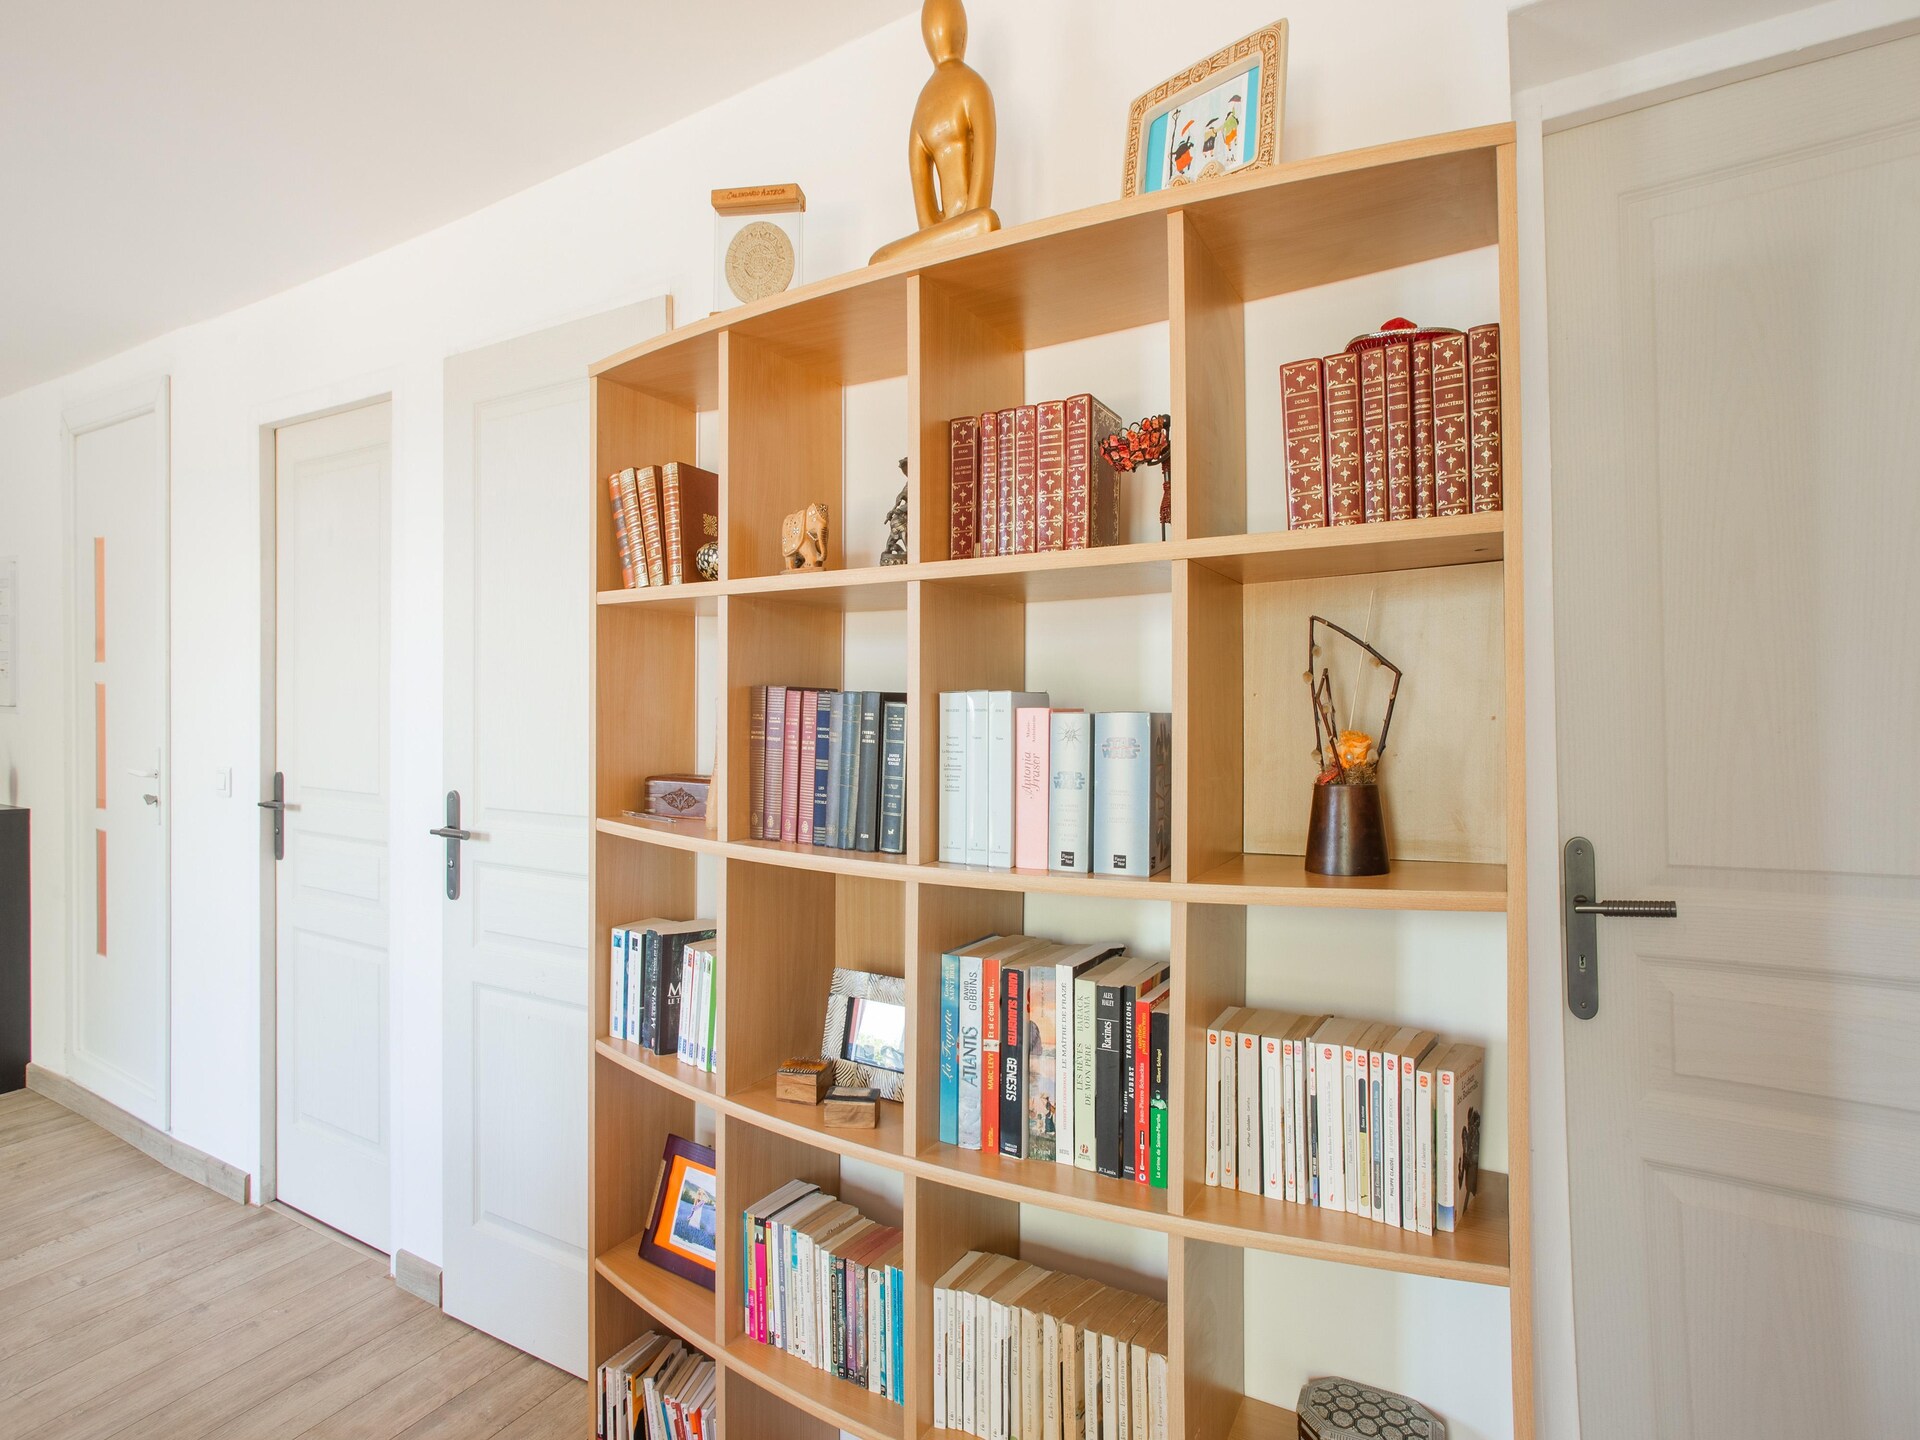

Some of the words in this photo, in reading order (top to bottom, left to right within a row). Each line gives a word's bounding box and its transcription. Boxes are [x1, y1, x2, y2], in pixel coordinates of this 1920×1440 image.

[1390, 382, 1406, 391] PASCAL
[1102, 737, 1140, 748] STAR
[1102, 748, 1140, 759] WARS
[1021, 752, 1033, 799] Antonia
[1031, 753, 1041, 792] Fraser
[968, 971, 977, 1011] GIBBINS
[1008, 972, 1018, 998] KARIN
[1007, 999, 1017, 1047] SLAUGHTER
[1061, 1010, 1067, 1023] DE
[941, 1009, 955, 1060] Fayette
[1101, 1021, 1112, 1049] Racines
[961, 1026, 978, 1088] ATLANTIS
[1061, 1058, 1067, 1069] LE
[1075, 1043, 1083, 1071] RÊVES
[1083, 1044, 1091, 1067] PÈRE
[941, 1063, 954, 1083] La
[1006, 1058, 1017, 1102] GENESIS
[1085, 1091, 1091, 1106] DE
